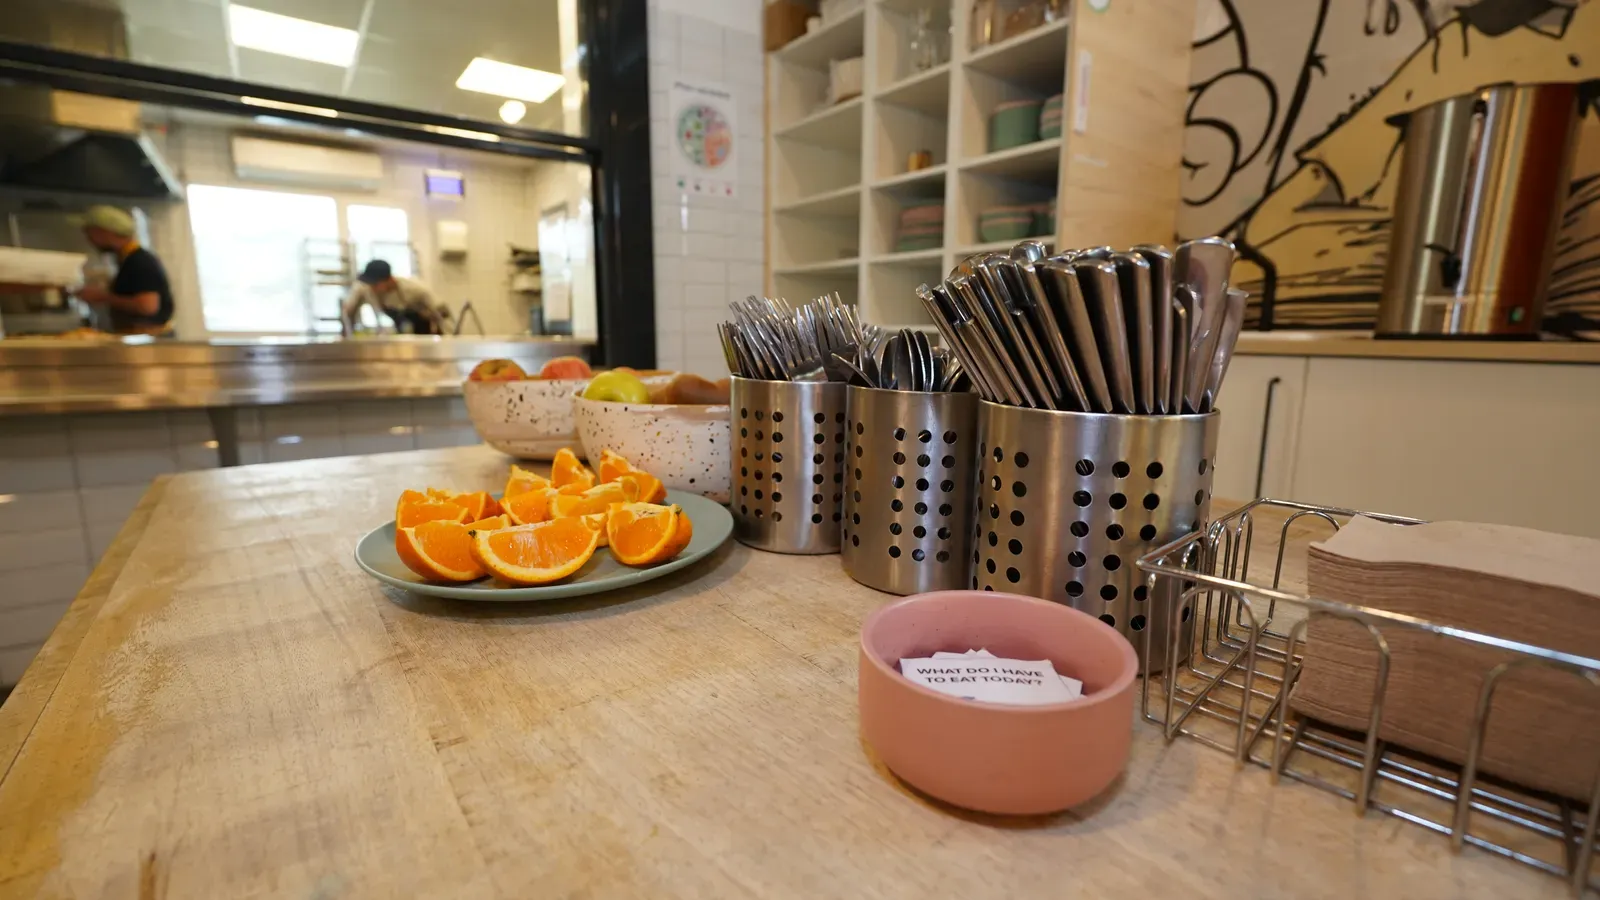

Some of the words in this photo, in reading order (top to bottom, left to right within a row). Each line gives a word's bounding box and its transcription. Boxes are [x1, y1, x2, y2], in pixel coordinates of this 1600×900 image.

[916, 667, 962, 675] WHAT
[1002, 668, 1044, 678] HAVE
[980, 676, 1043, 686] TODAY?
